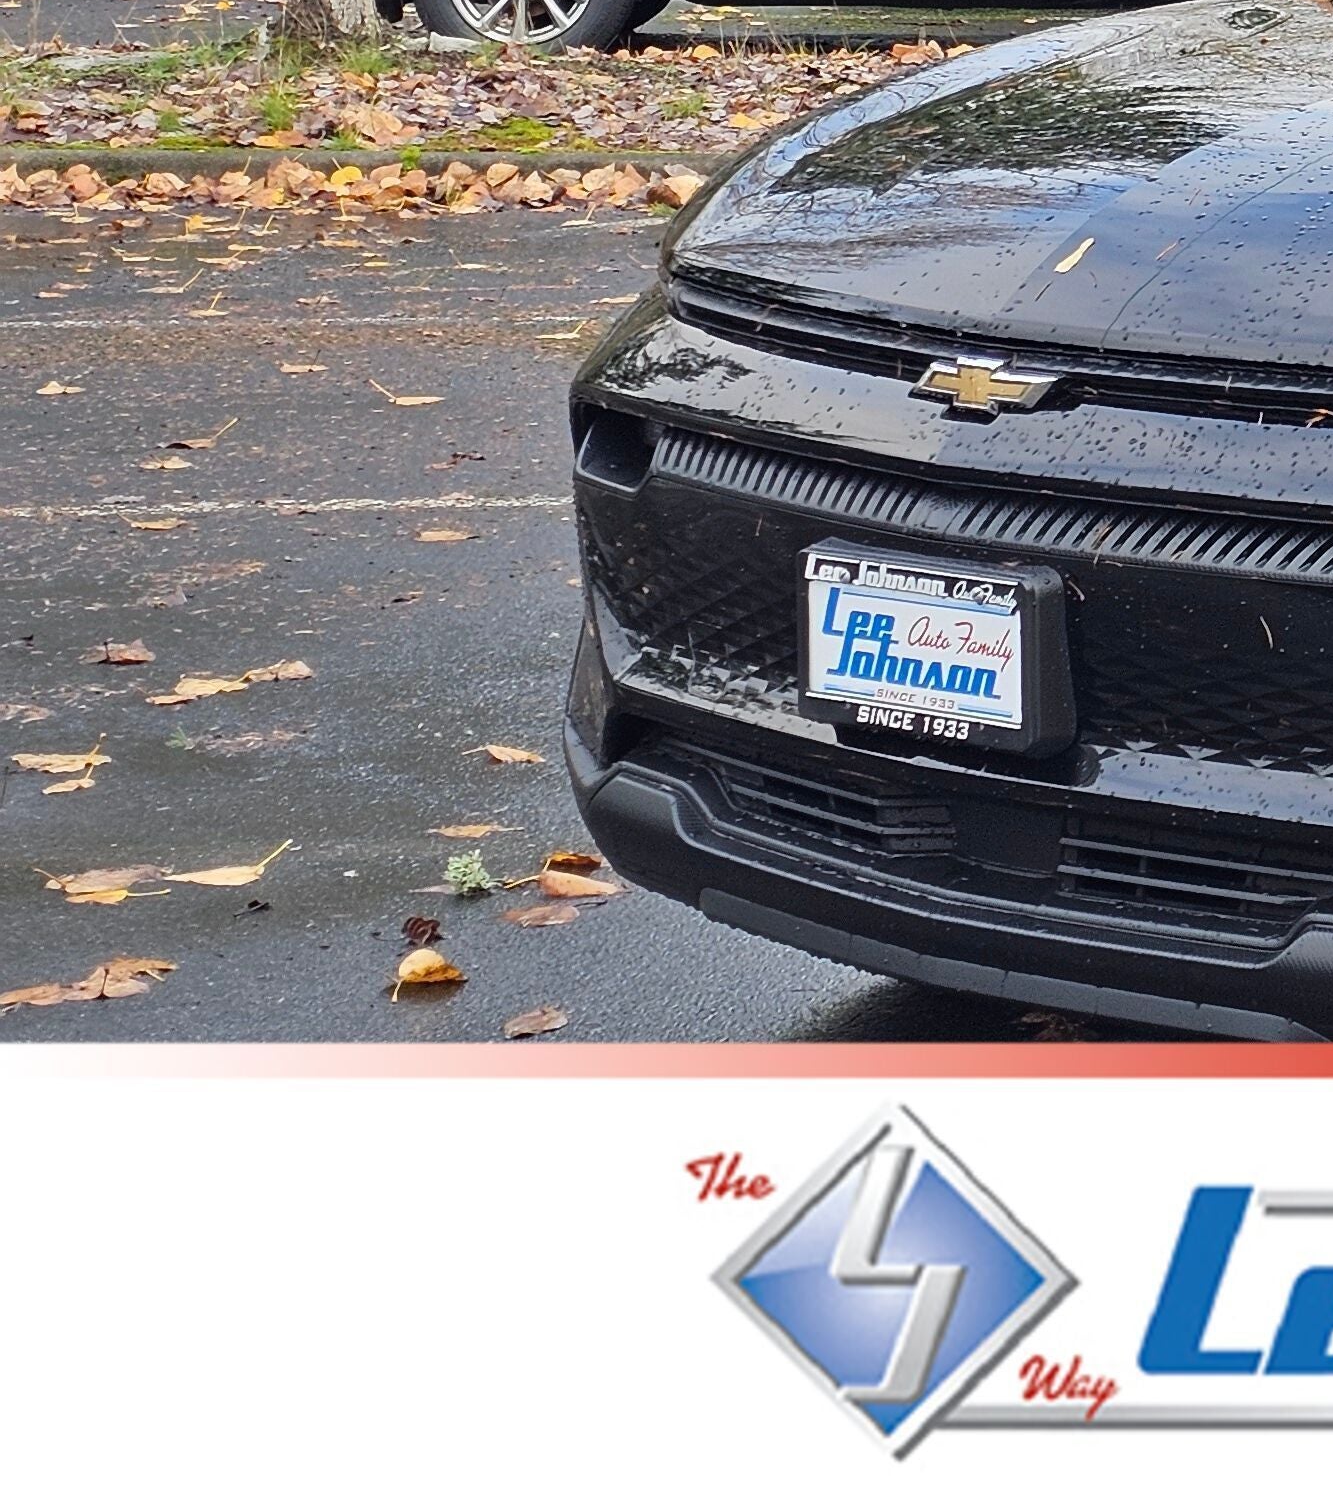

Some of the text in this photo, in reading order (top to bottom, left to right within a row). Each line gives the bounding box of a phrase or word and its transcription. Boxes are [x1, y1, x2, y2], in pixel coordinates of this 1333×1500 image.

[852, 560, 949, 597] Johnson
[822, 587, 899, 645] Lee
[826, 633, 1002, 700] Johnson
[907, 616, 1014, 673] Auto Family
[876, 687, 956, 711] SINCE 1933
[856, 705, 970, 741] SINCE 1933
